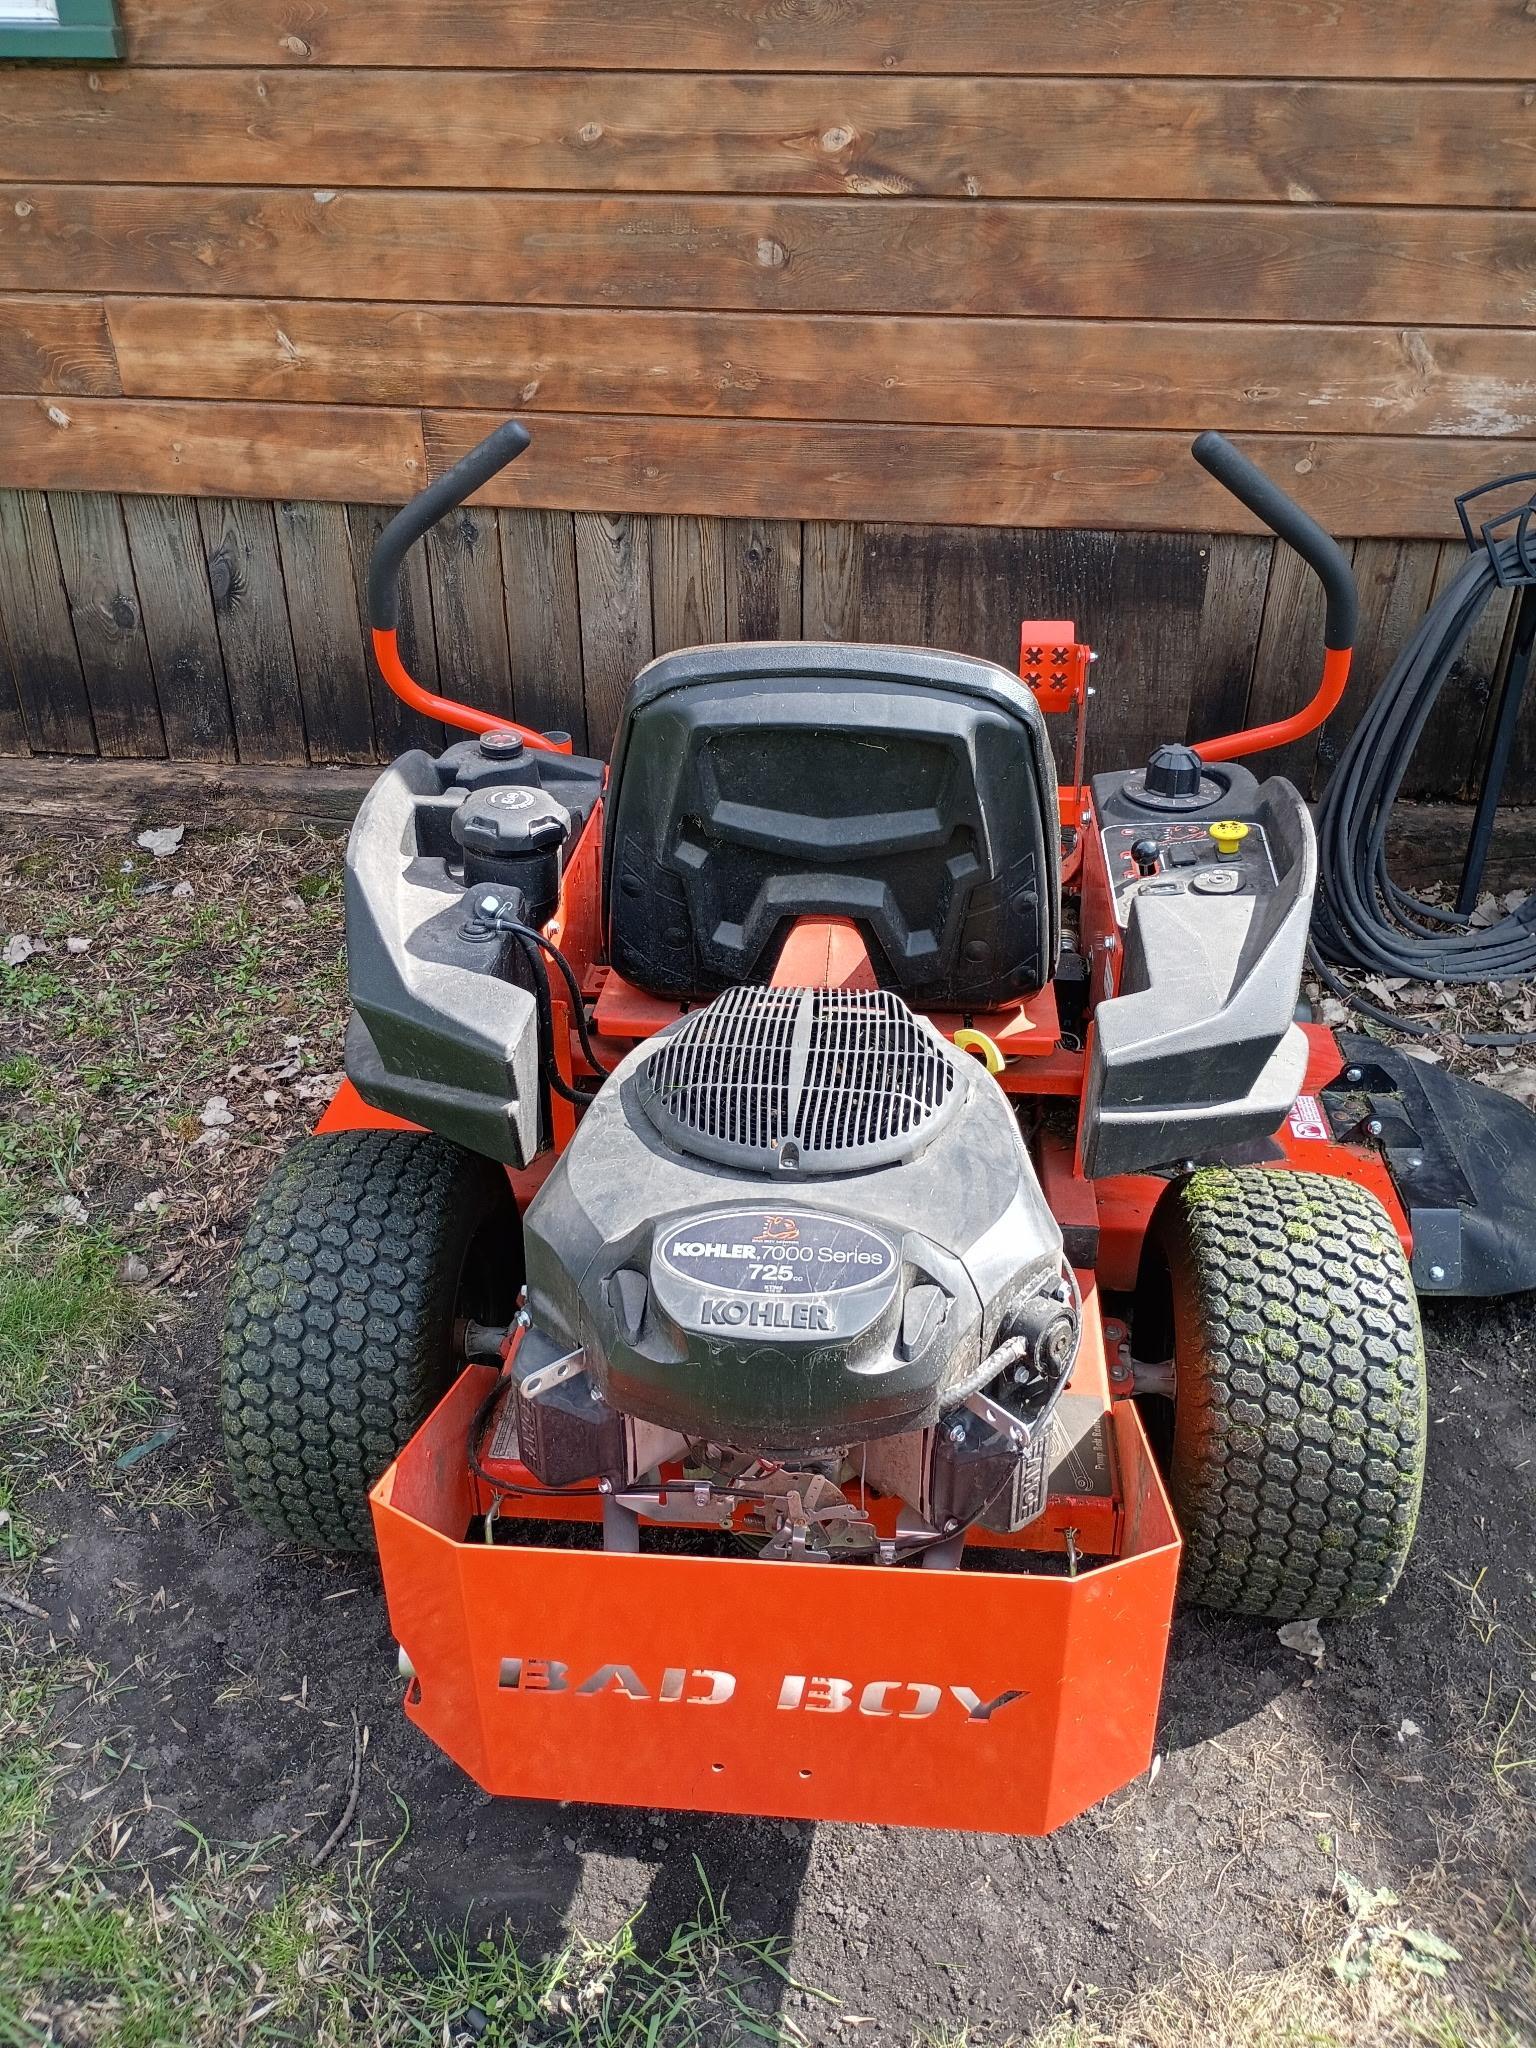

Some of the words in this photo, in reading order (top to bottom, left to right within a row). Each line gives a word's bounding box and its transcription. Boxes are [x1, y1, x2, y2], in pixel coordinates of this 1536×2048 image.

[673, 1242, 757, 1260] KOHLER
[761, 1245, 813, 1262] 7000
[817, 1247, 883, 1265] Series
[701, 1301, 831, 1330] KOHLER
[498, 1657, 737, 1705] BAD
[777, 1674, 1032, 1723] BOY
